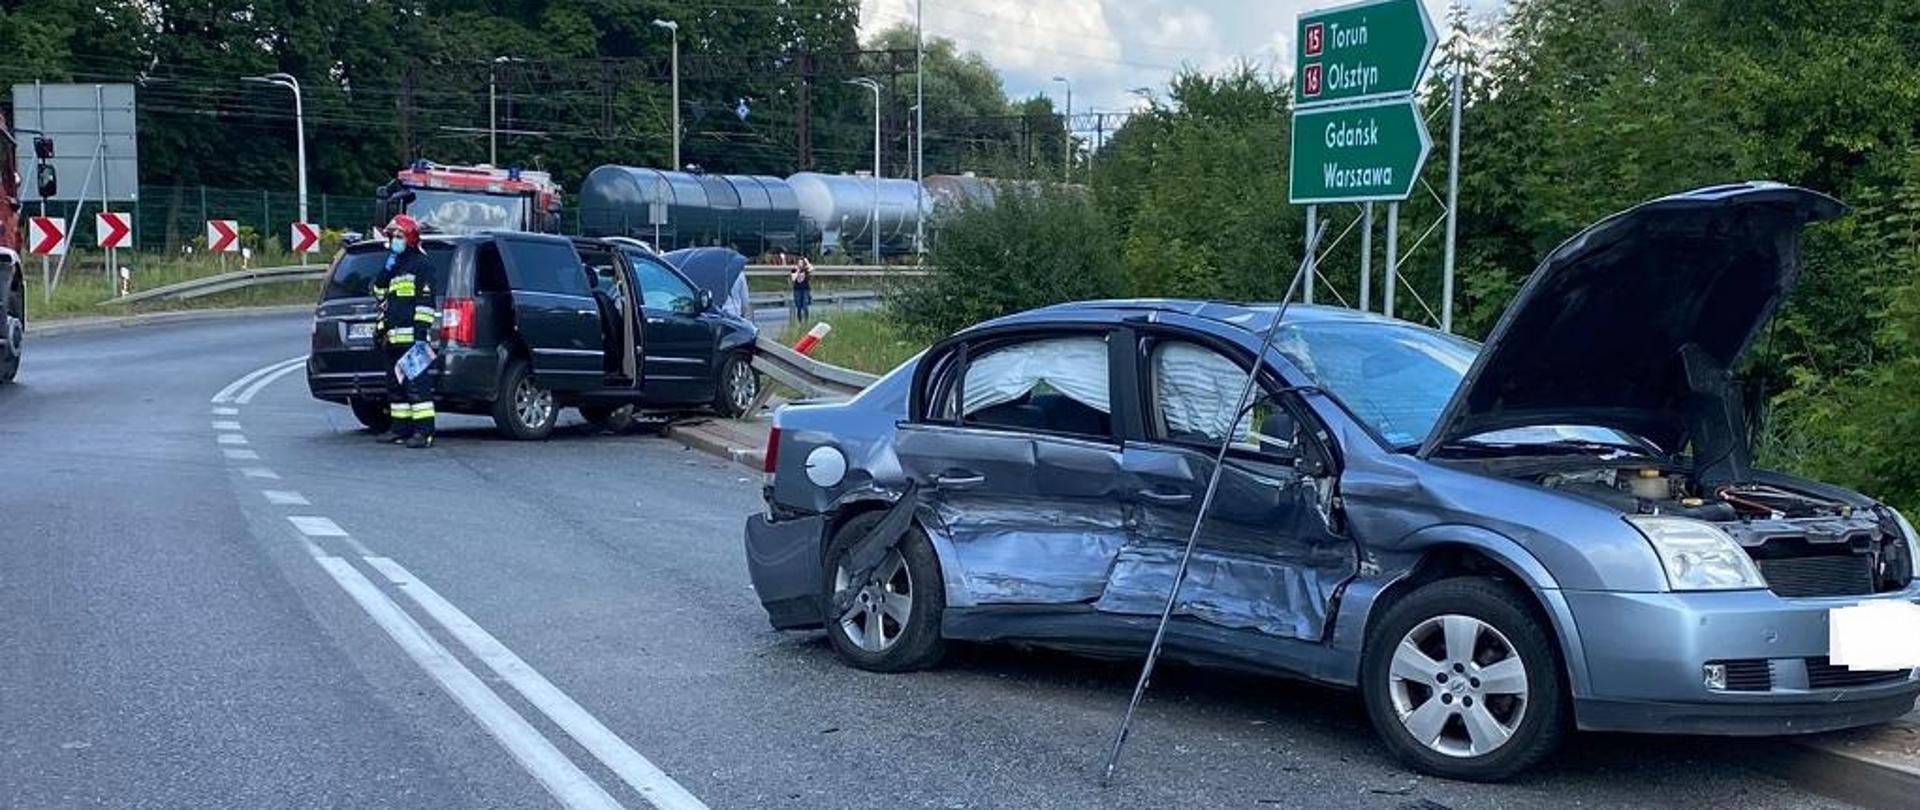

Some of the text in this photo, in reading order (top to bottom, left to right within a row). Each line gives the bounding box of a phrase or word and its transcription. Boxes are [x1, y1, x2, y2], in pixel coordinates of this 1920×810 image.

[1308, 17, 1368, 50] 15 Toruń
[1307, 62, 1378, 93] 16 Olsztyn
[1325, 118, 1379, 148] Gdańsk
[1323, 162, 1393, 189] Warszawa
